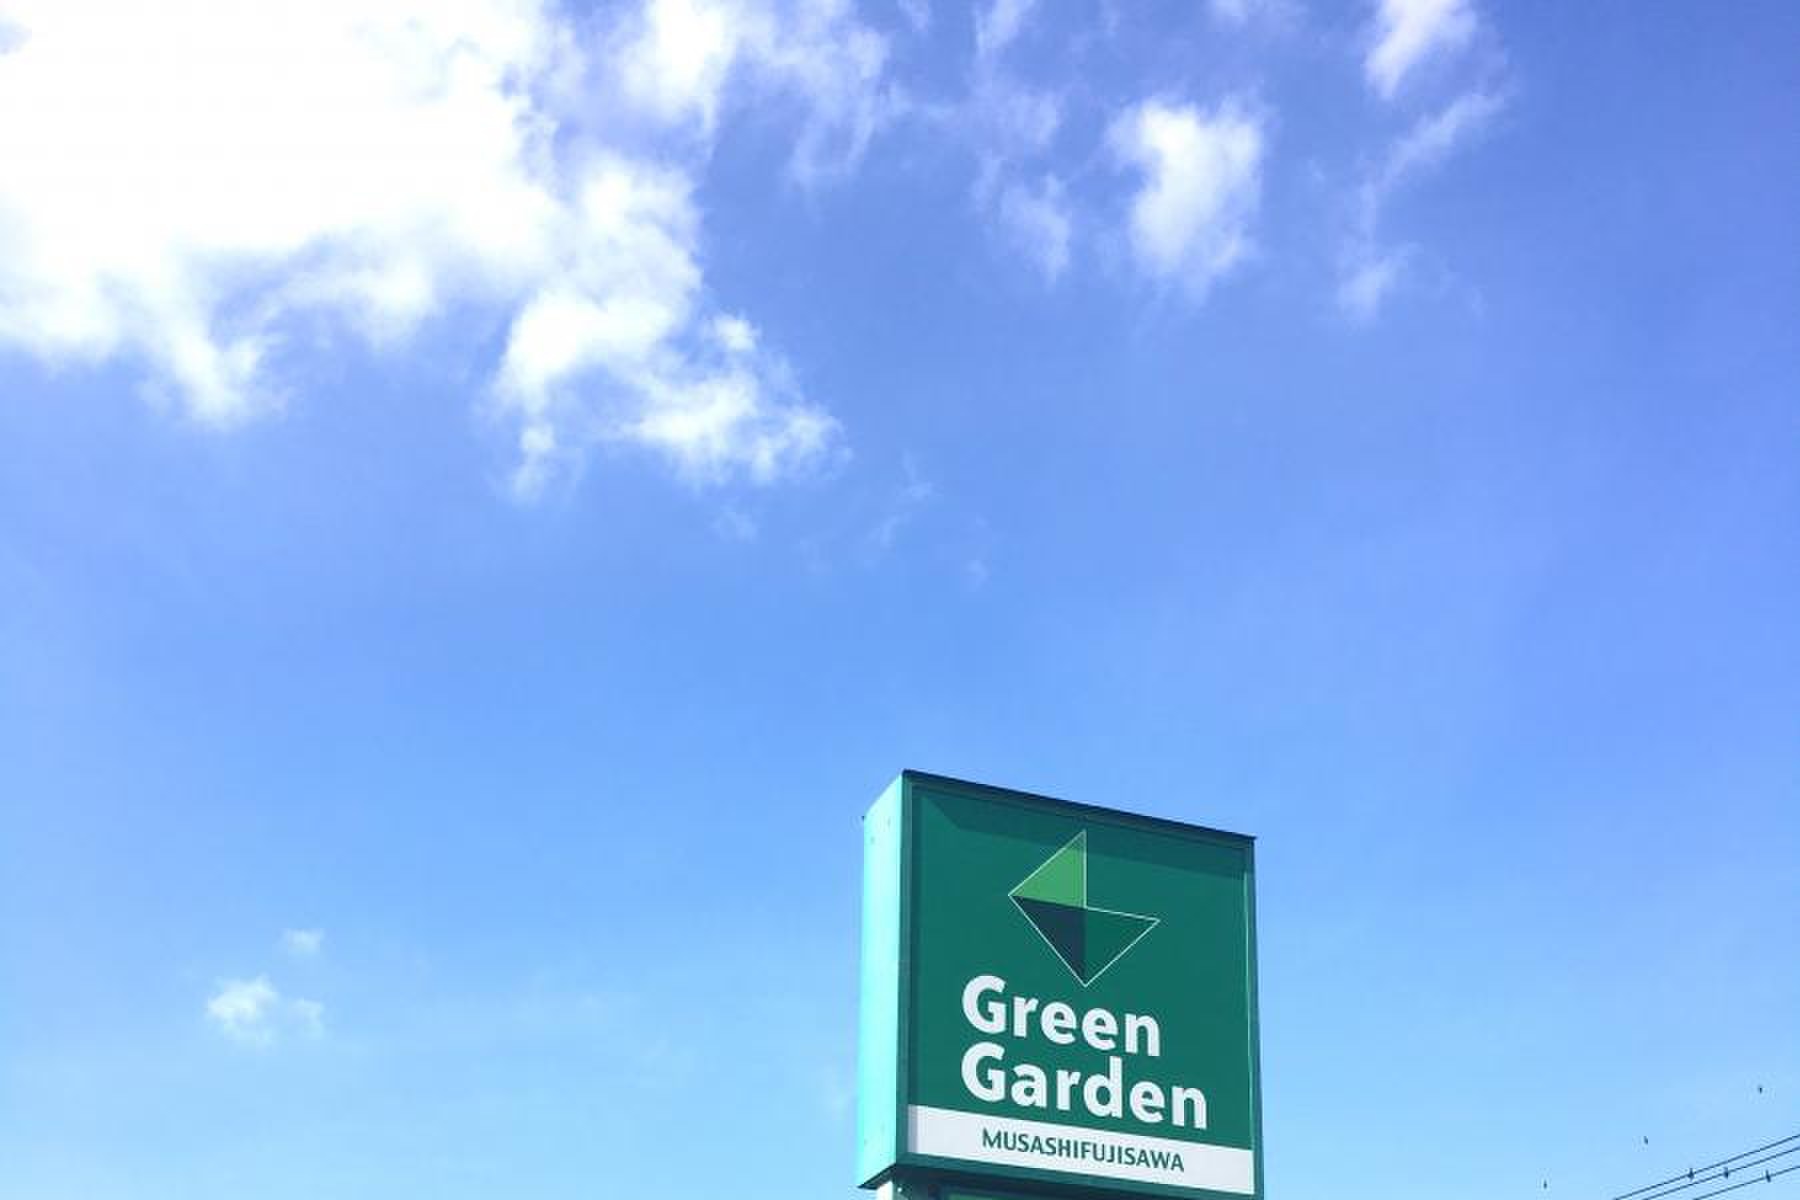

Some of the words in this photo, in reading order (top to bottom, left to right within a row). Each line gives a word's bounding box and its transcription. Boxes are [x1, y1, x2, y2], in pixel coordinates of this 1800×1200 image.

[962, 975, 1160, 1057] Green
[961, 1041, 1207, 1129] Garden
[982, 1128, 1184, 1173] MUSASHIFUJISAWA
